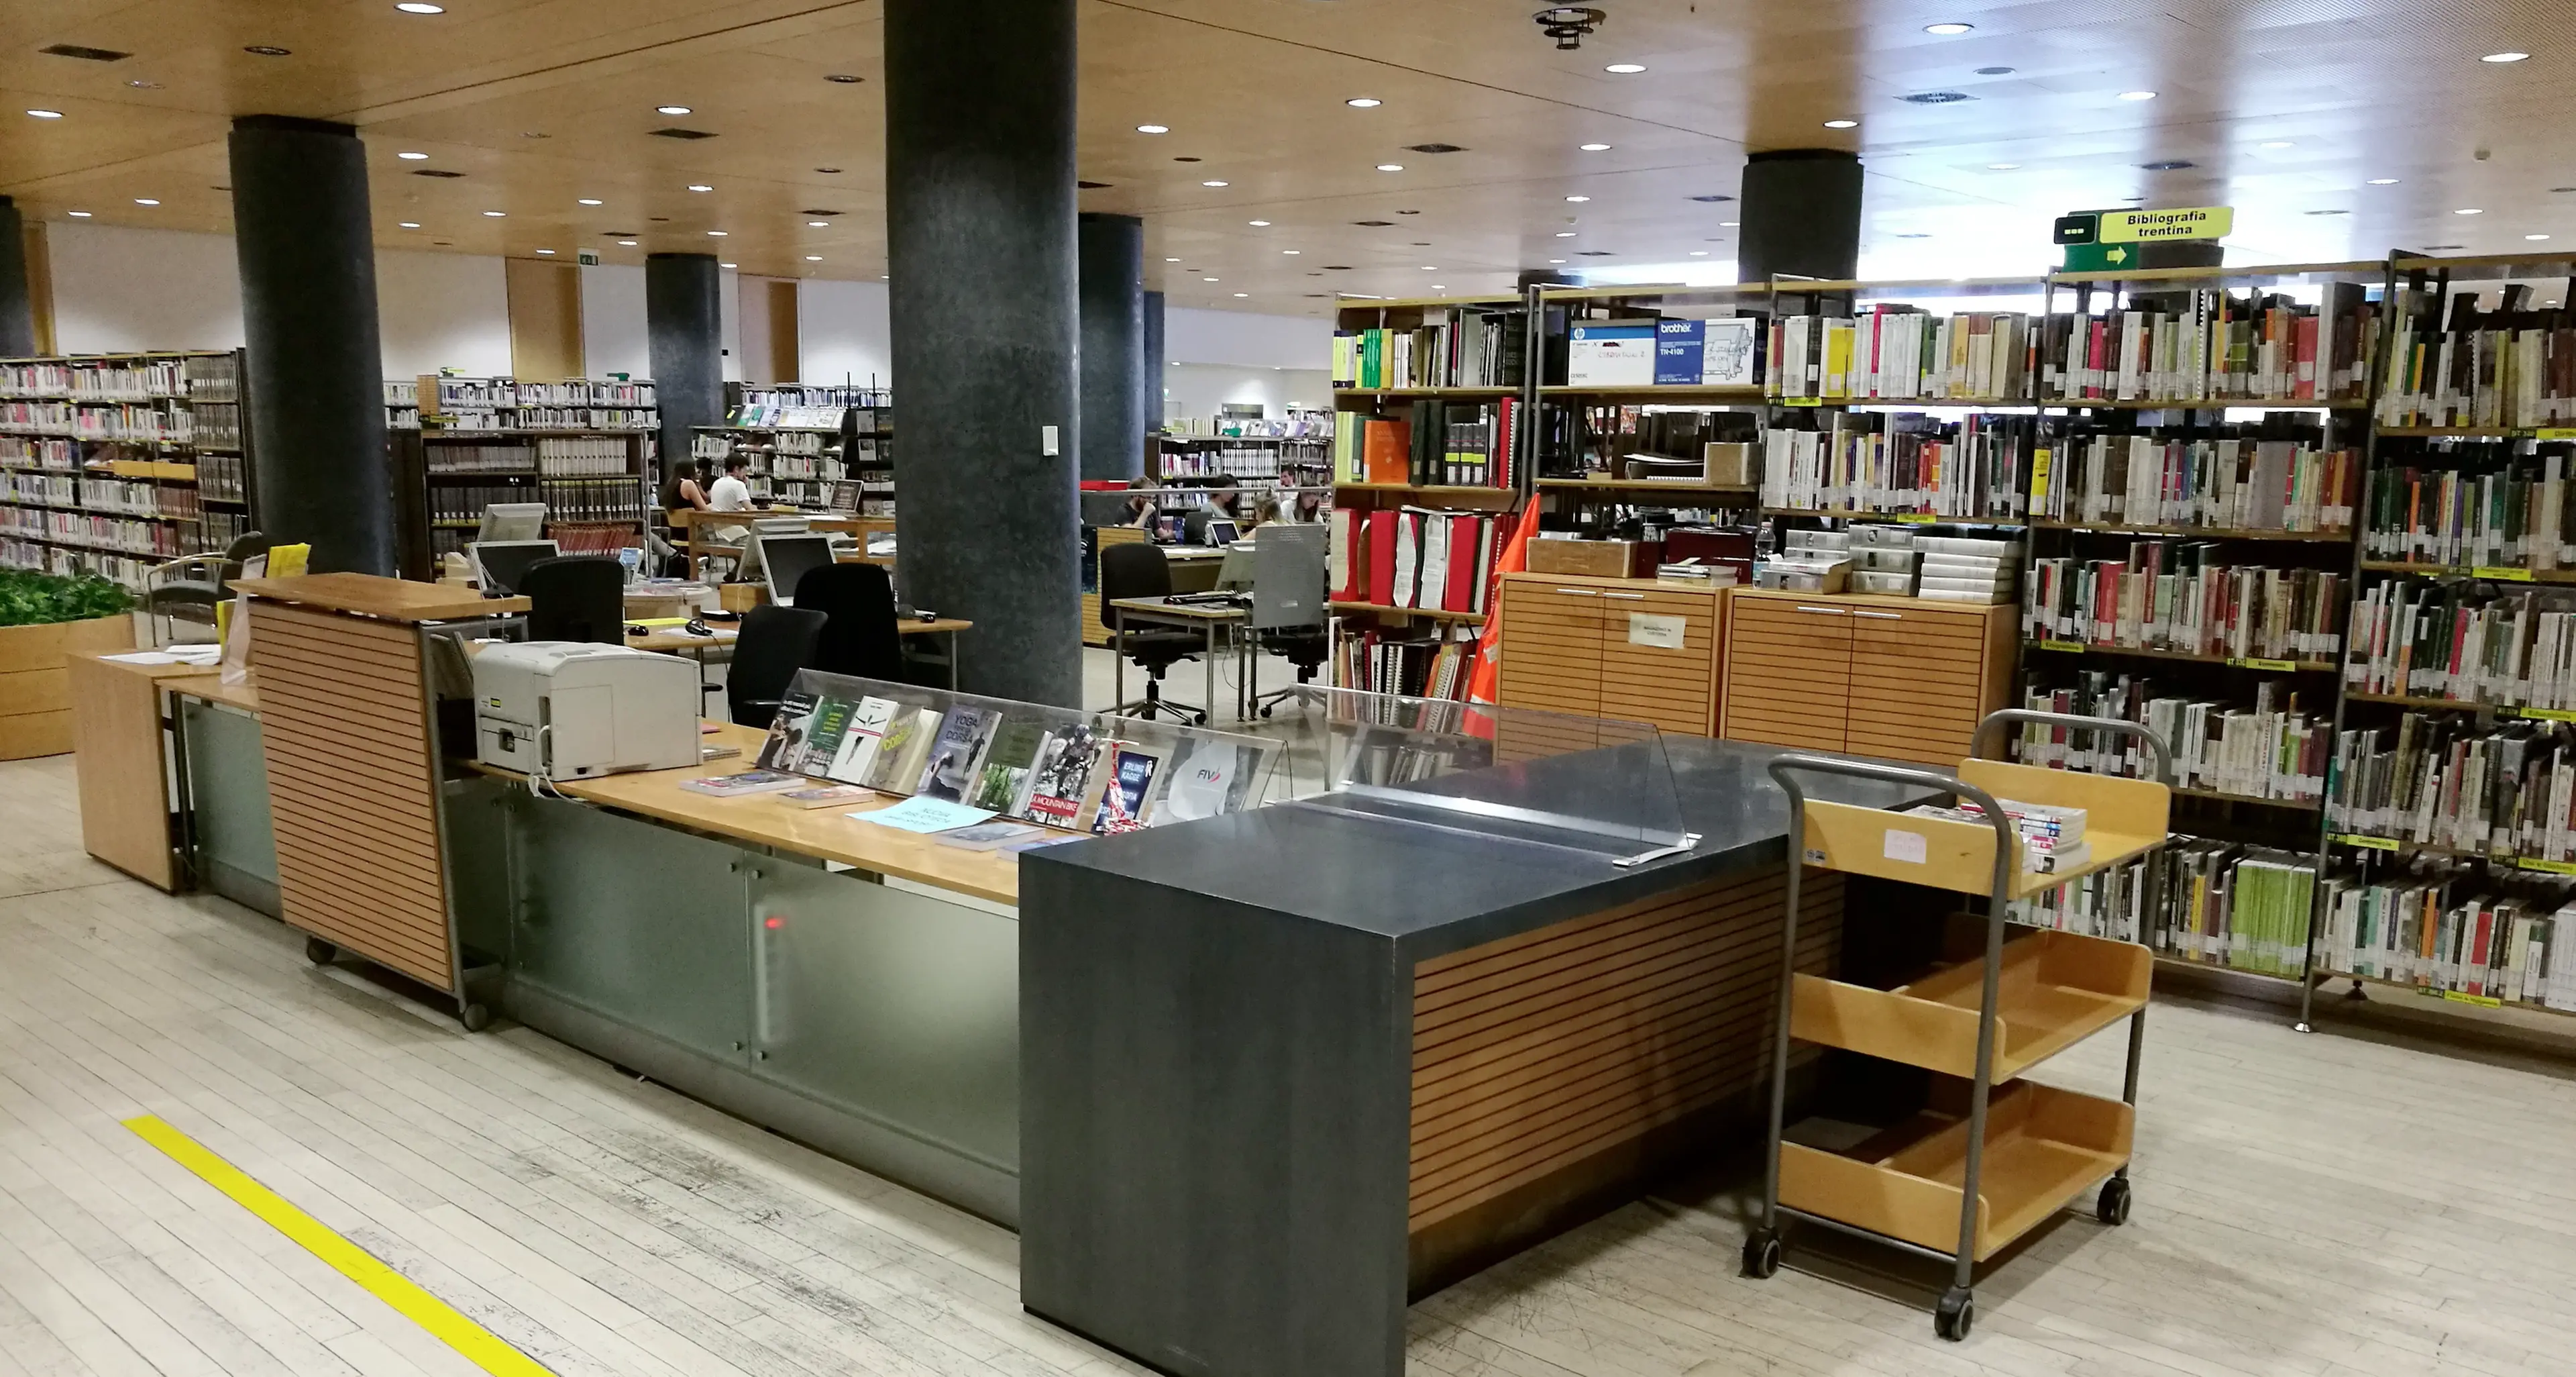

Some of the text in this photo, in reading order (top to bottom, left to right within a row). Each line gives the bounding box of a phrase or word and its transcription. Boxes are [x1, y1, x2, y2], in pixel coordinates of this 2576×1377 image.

[2127, 211, 2206, 225] Bibliografia
[2139, 225, 2193, 237] trentina
[1660, 323, 1691, 334] brother
[955, 715, 977, 727] YOGA
